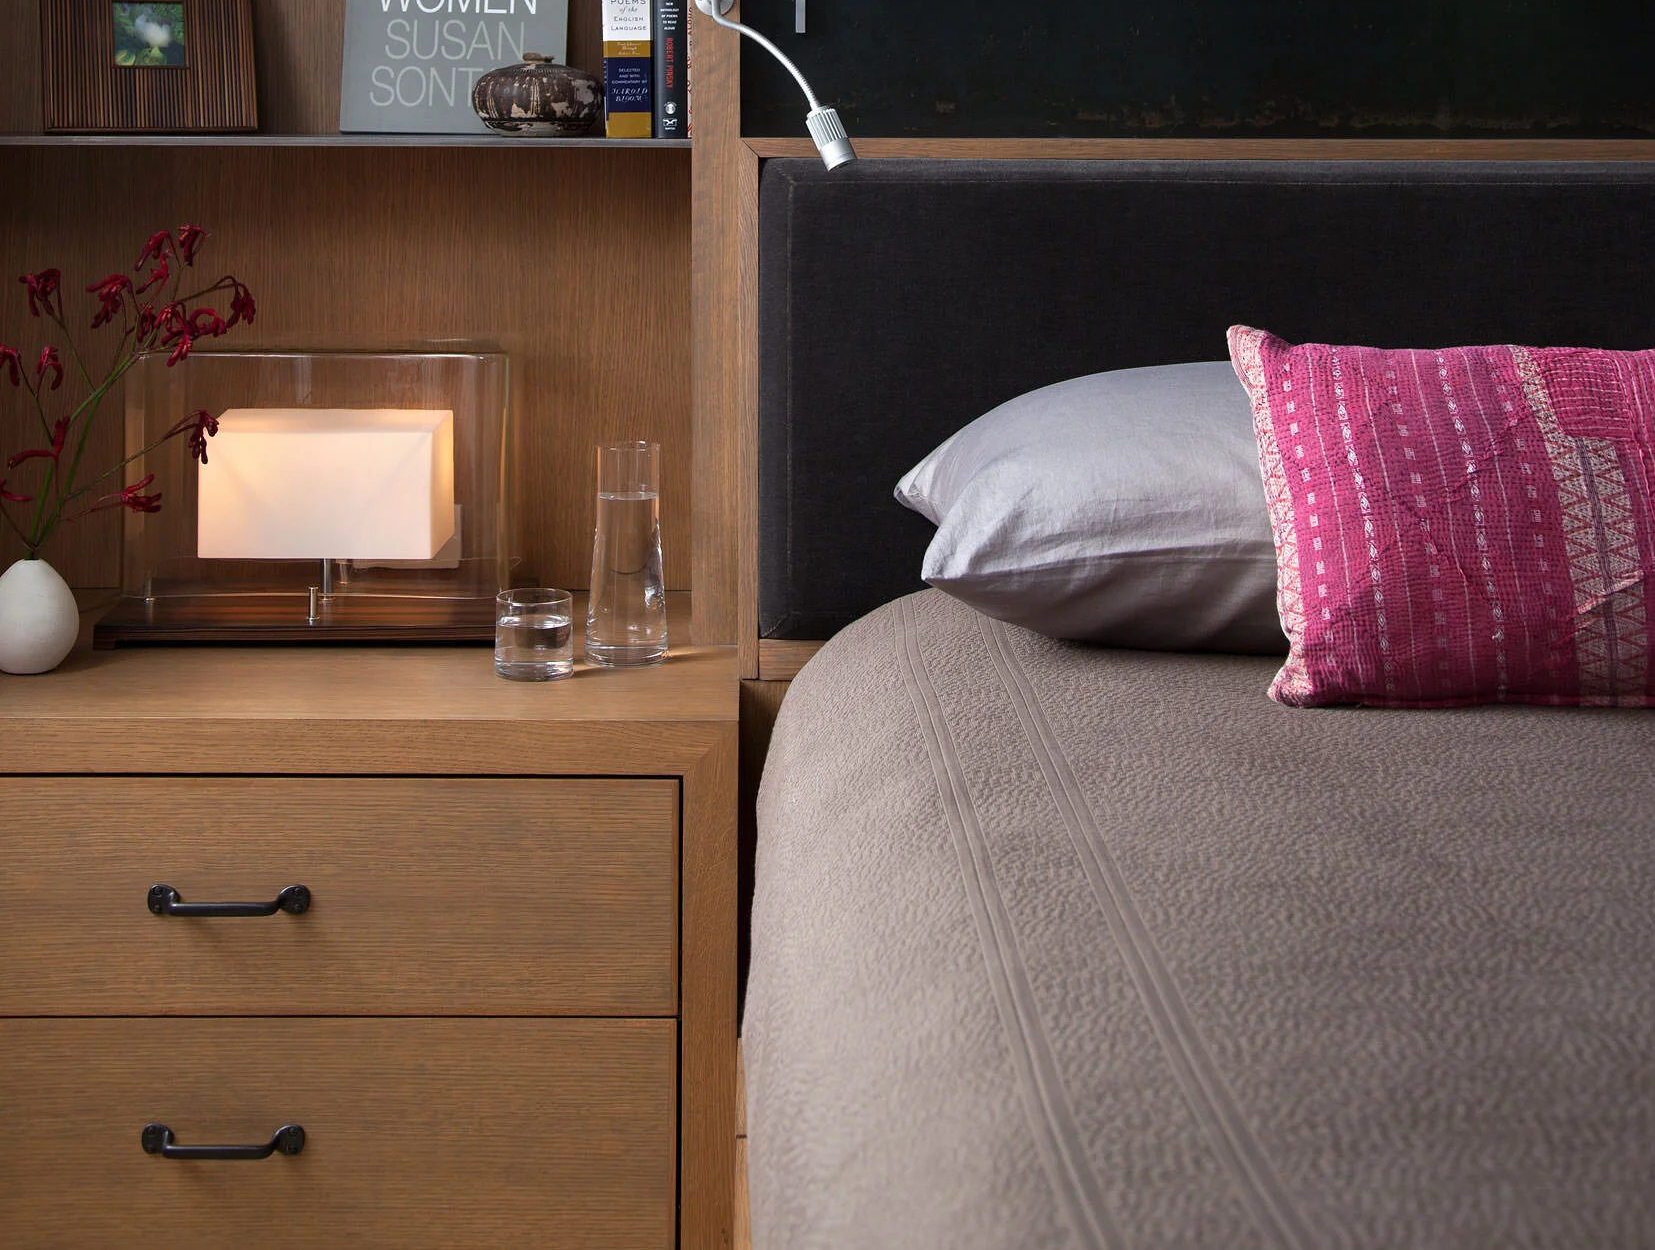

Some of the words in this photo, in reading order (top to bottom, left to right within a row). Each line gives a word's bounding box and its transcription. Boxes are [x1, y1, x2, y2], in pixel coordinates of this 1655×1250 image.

[619, 6, 627, 15] of
[384, 18, 525, 61] SUSAN
[666, 37, 674, 63] ROBERT
[368, 65, 486, 108] SONT
[666, 64, 674, 89] PINSKY
